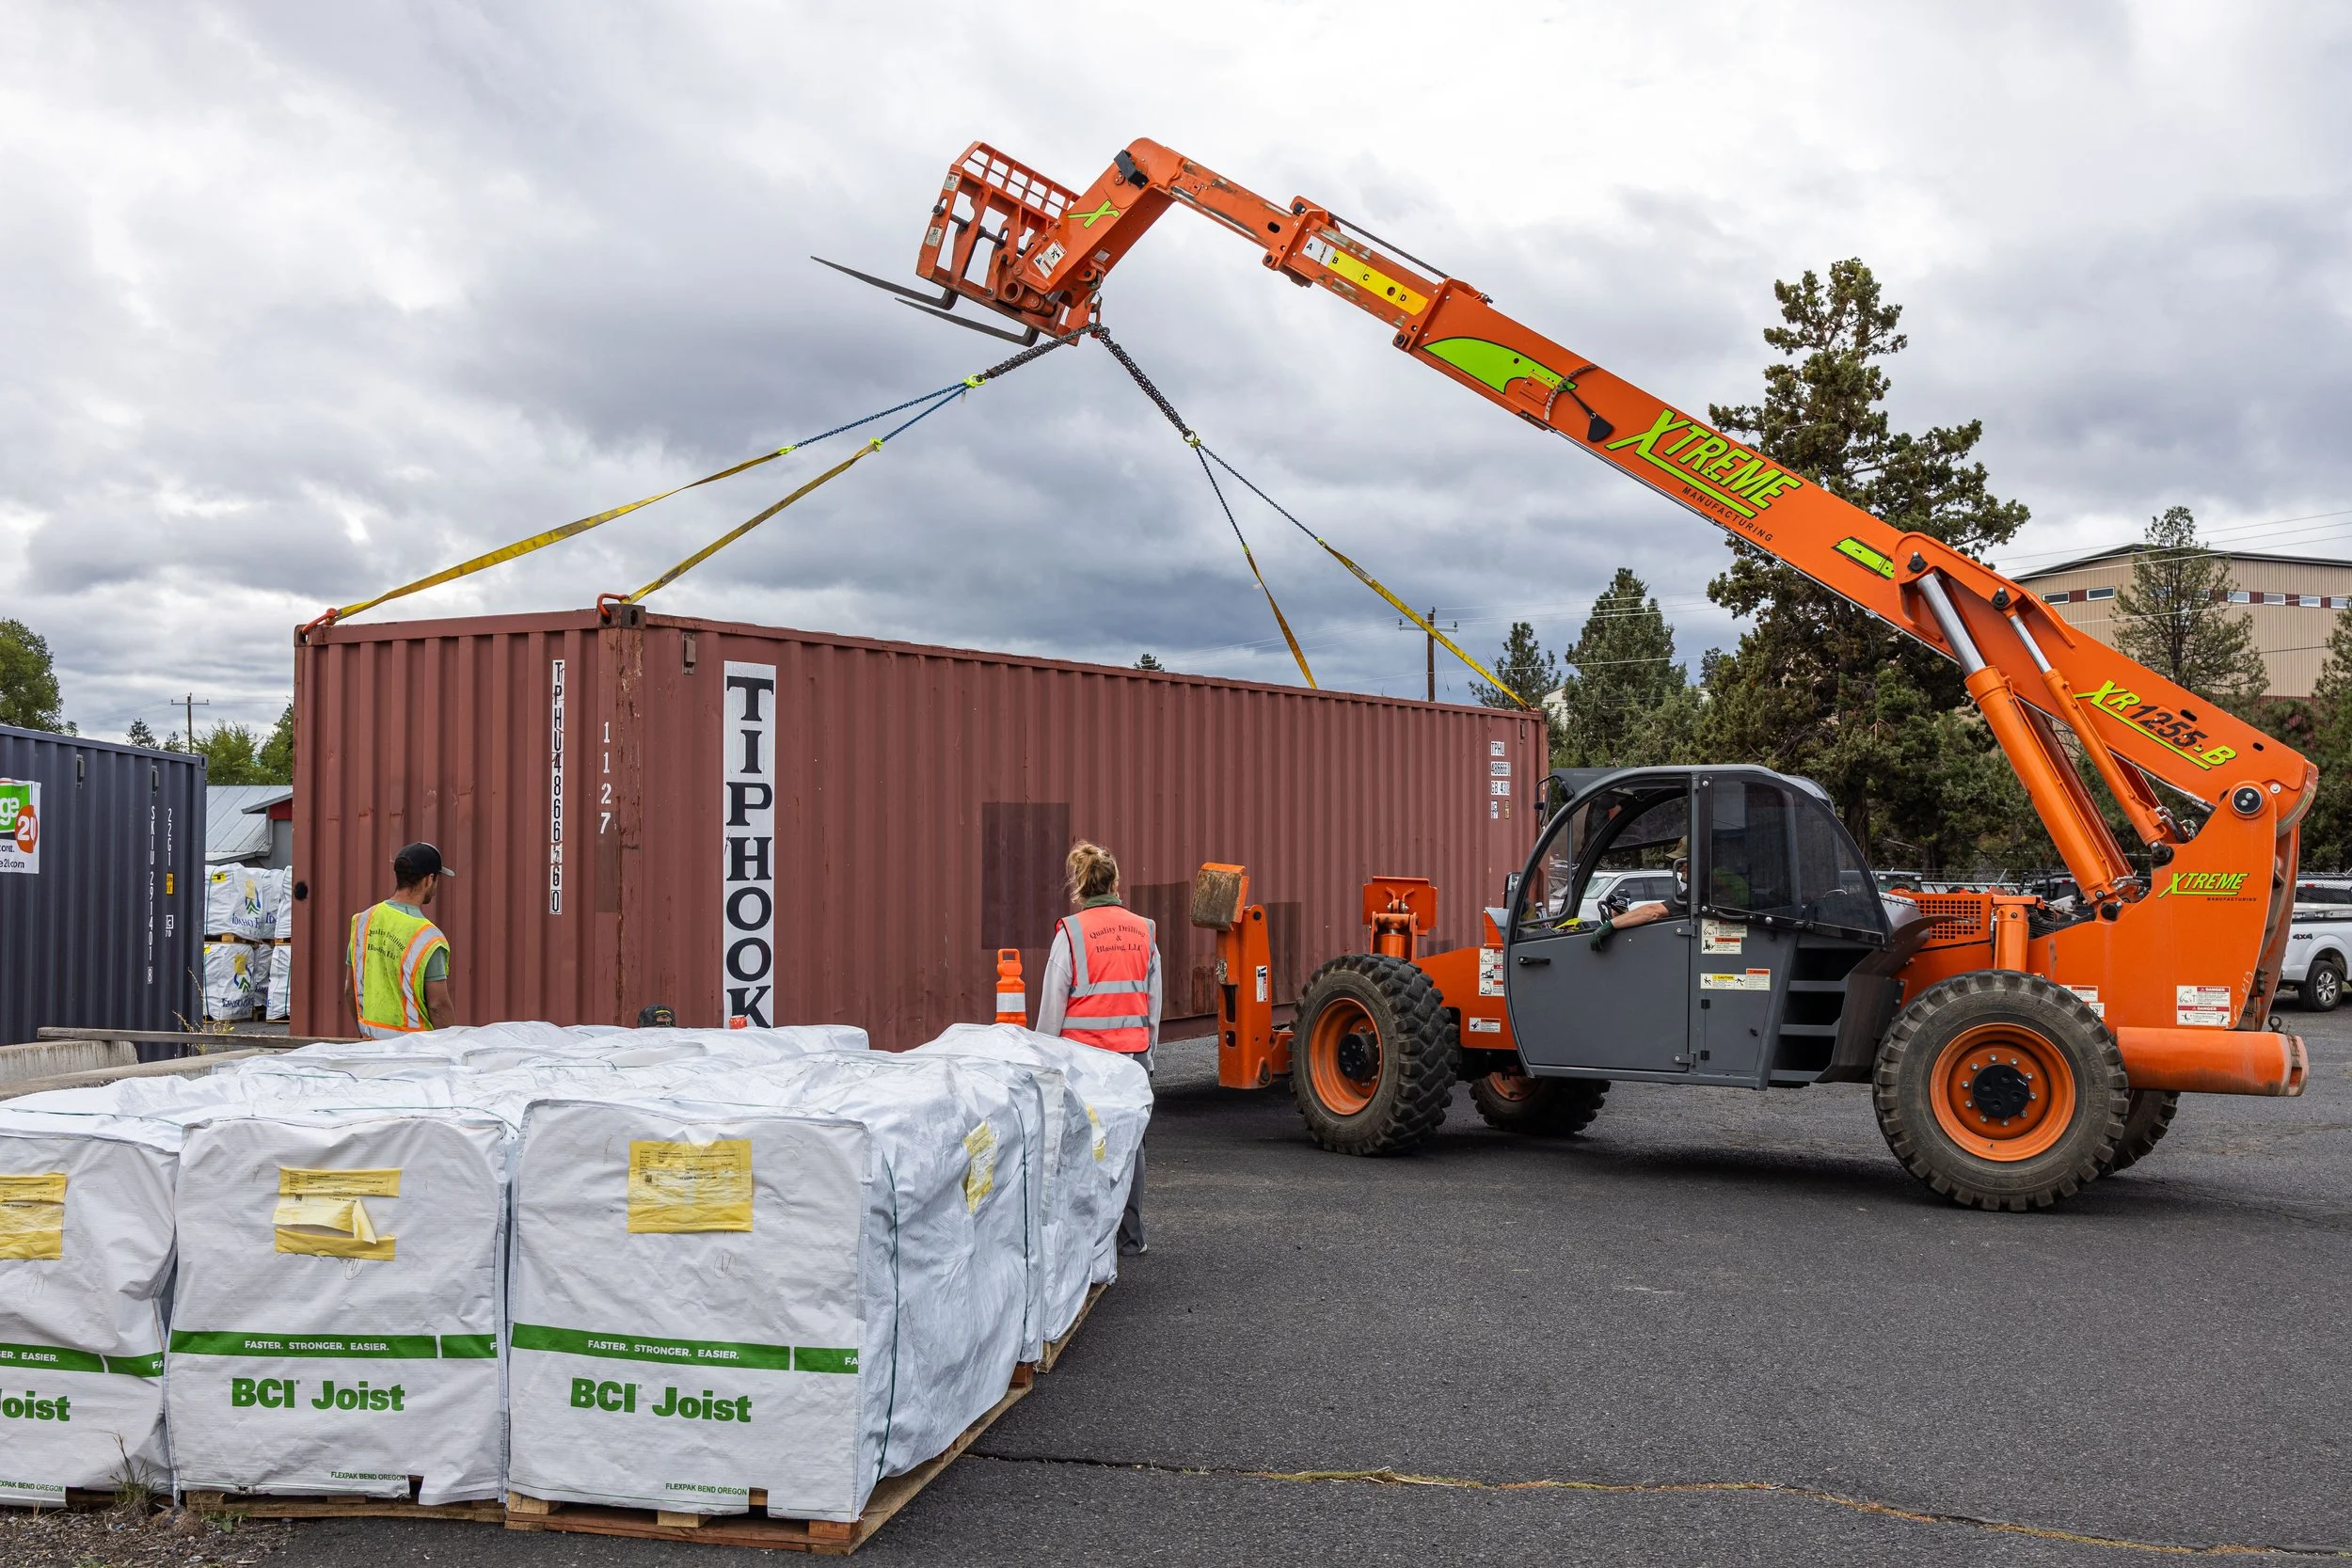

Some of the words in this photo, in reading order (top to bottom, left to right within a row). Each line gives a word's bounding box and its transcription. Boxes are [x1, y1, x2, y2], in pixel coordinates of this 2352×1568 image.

[1306, 243, 1313, 251] A
[1331, 256, 1339, 264] B
[1399, 293, 1407, 302] D
[1604, 408, 1803, 513] XTREME
[1681, 485, 1773, 542] MANUFACTURING
[725, 675, 774, 1029] TIPHOOK
[2157, 873, 2249, 897] XTREME
[1089, 927, 1116, 939] Quality
[1118, 925, 1146, 938] Drilling
[245, 1340, 284, 1350] FASTER.
[288, 1341, 345, 1351] STRONGER.
[350, 1342, 389, 1352] EASIER.
[587, 1339, 628, 1352] FASTER.
[634, 1344, 691, 1357] STRONGER.
[697, 1349, 739, 1360] EASIER.
[21, 1352, 58, 1363] EASIER.
[311, 1380, 405, 1411] Joist
[0, 1388, 71, 1421] oist
[651, 1386, 753, 1423] Joist
[330, 1471, 358, 1480] FLEXPAK
[359, 1472, 377, 1481] BEND
[378, 1473, 406, 1481] OREGON
[18, 1481, 35, 1490] BEND
[36, 1483, 63, 1493] OREGON
[665, 1482, 696, 1492] FLEXPAK
[697, 1483, 716, 1494] BEND
[717, 1485, 747, 1496] OREGON
